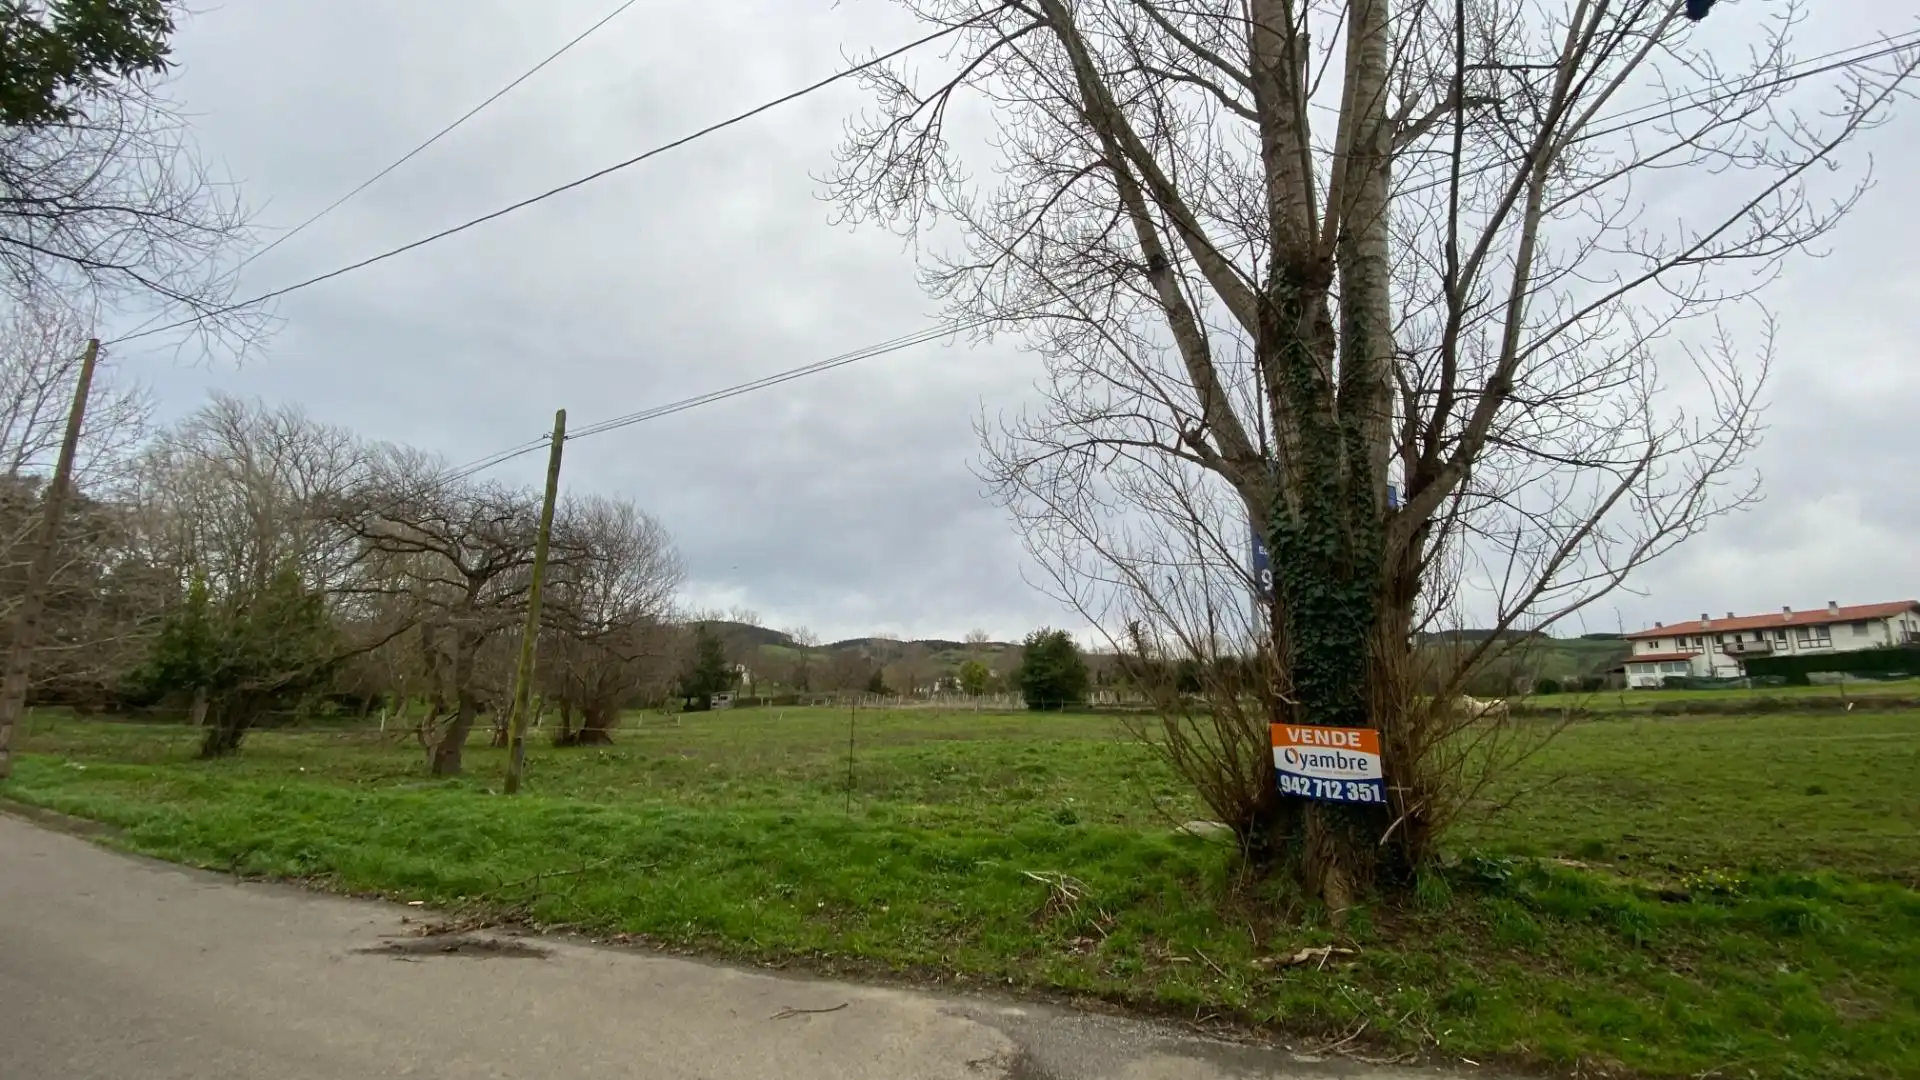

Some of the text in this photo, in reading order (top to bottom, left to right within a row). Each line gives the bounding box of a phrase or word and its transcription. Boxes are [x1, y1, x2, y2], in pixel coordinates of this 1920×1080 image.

[1286, 727, 1362, 747] VENDE
[1284, 747, 1368, 771] Oyambre
[1280, 774, 1381, 802] 942 712 351
